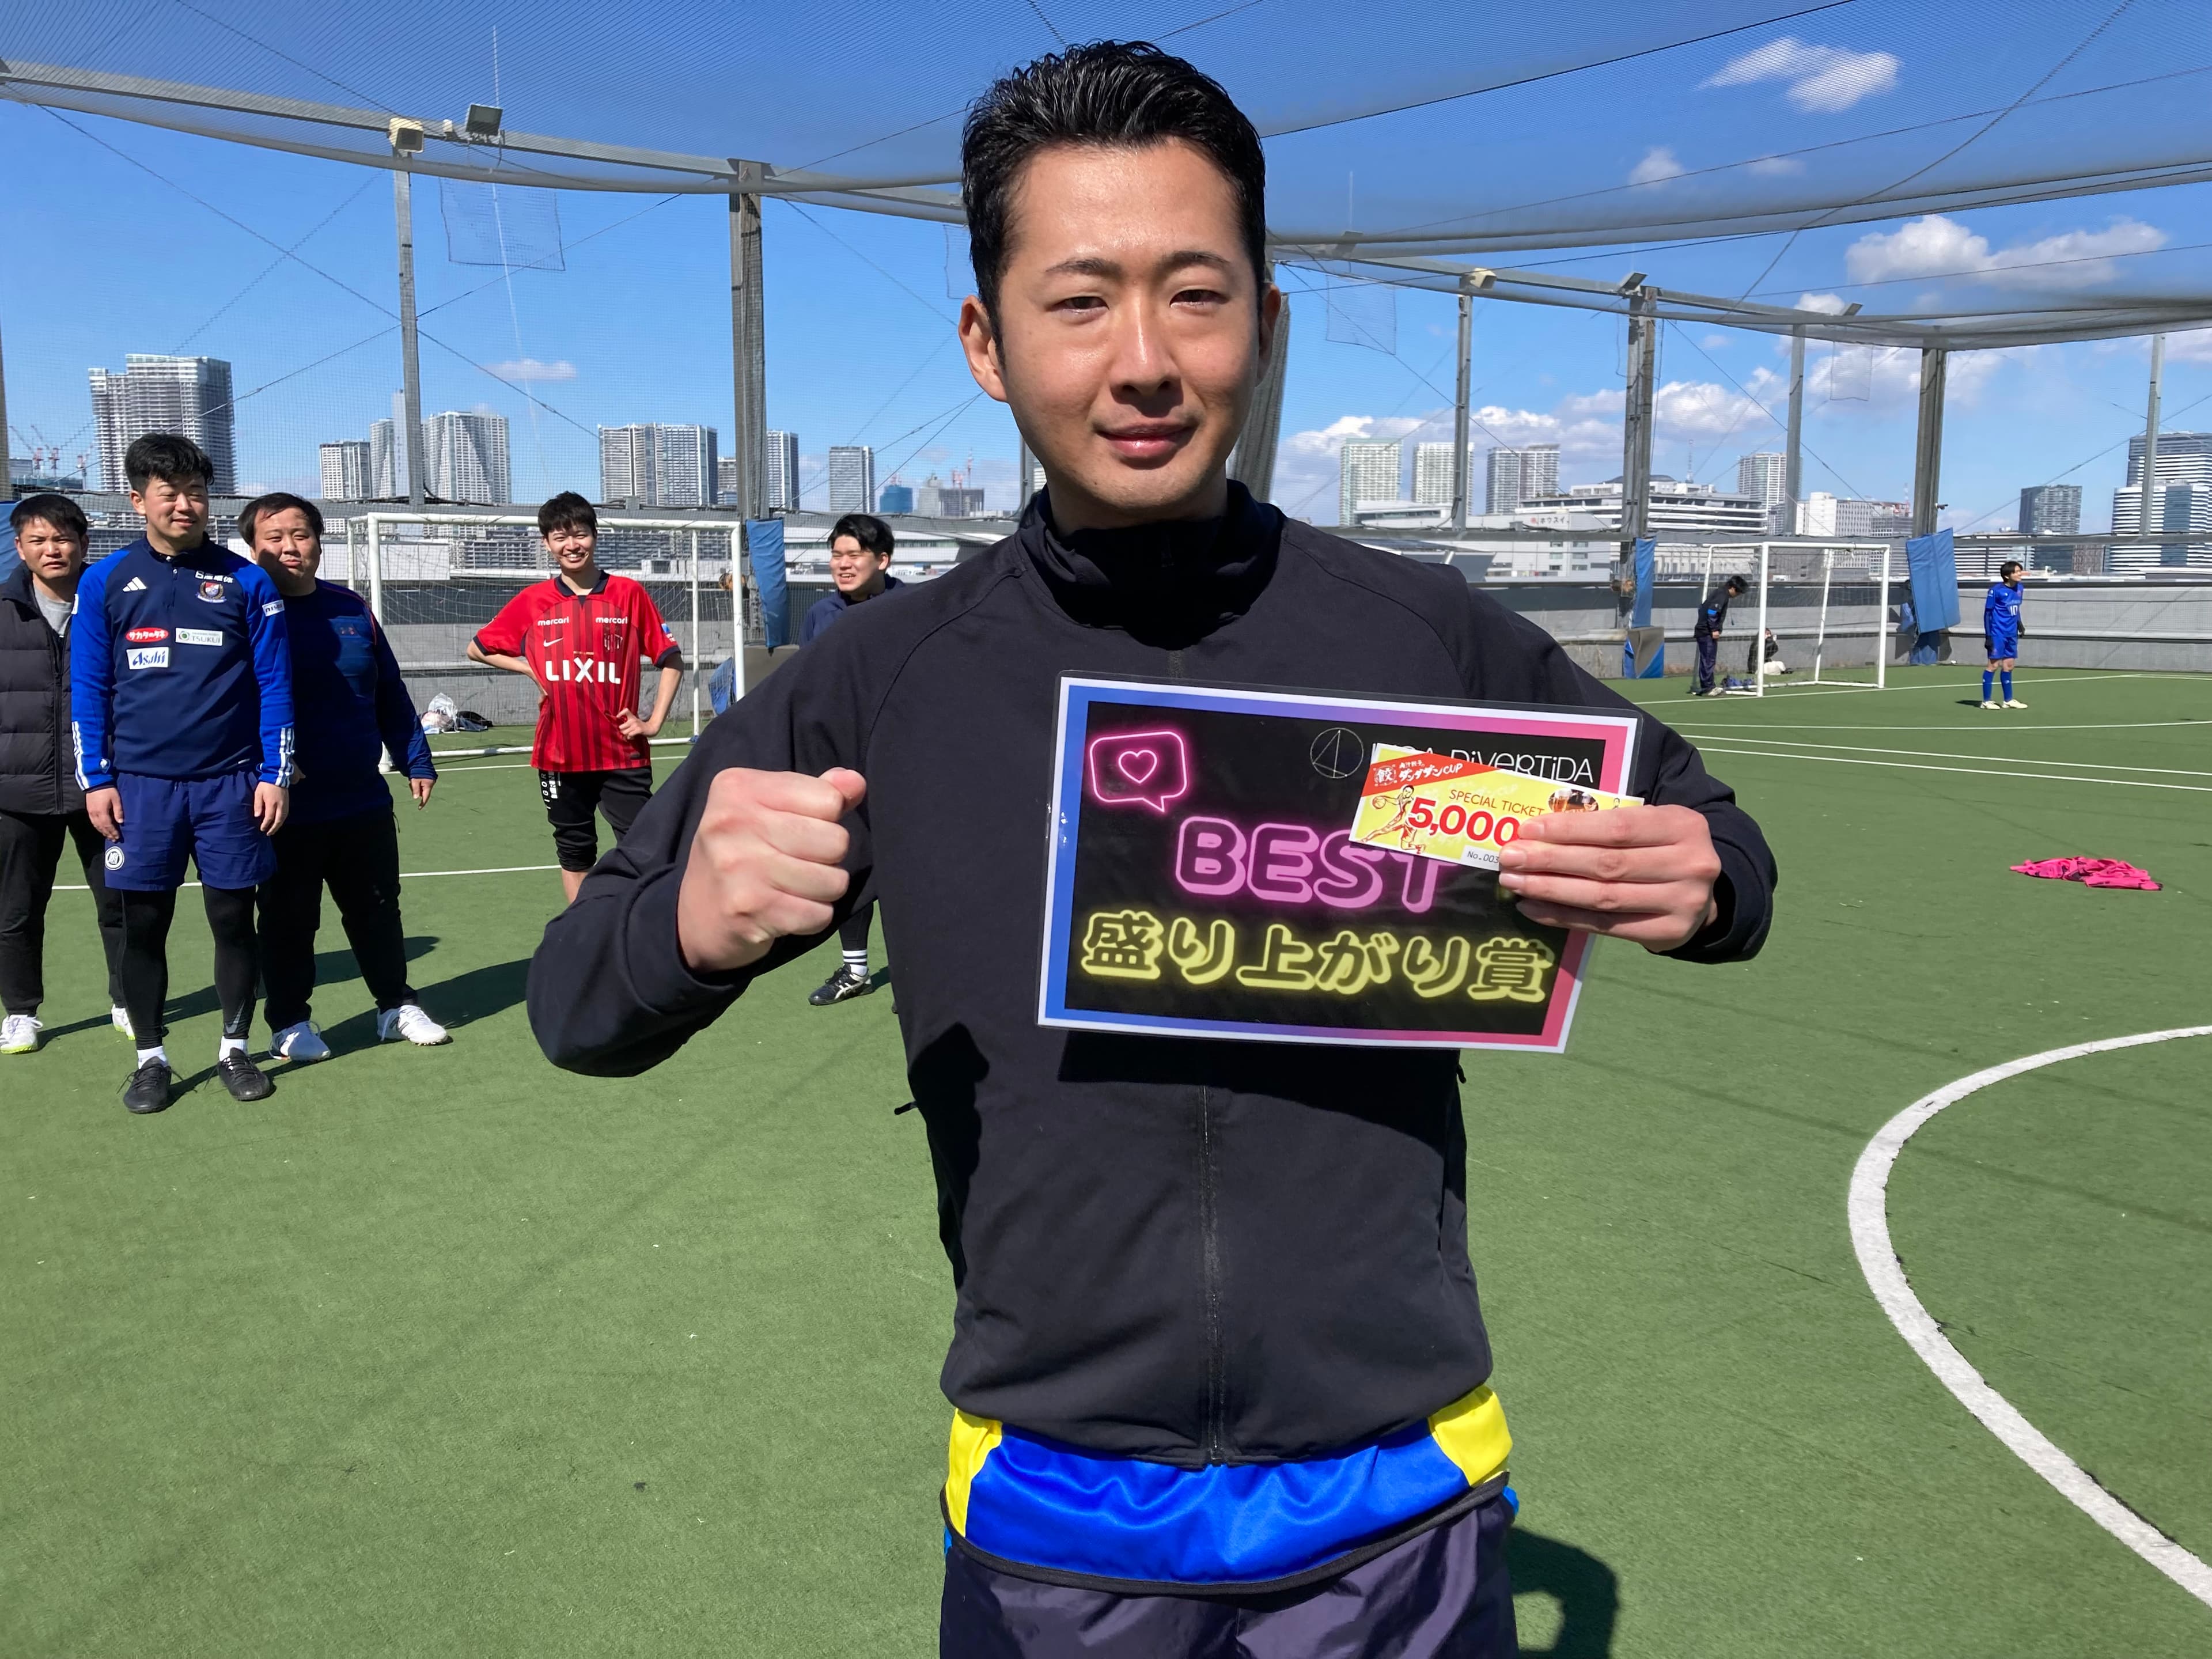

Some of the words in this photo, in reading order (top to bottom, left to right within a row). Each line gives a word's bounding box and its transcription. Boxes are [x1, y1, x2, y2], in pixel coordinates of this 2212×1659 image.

[2010, 605, 2018, 616] 10
[537, 616, 569, 626] mercari
[596, 616, 628, 624] mercari
[128, 630, 166, 640] サカタのタネ
[192, 635, 221, 643] TSUKUI
[132, 650, 165, 666] Asahi
[546, 657, 620, 684] LIXIL
[1449, 789, 1498, 809] SPECIAL
[1502, 800, 1545, 817] TICKET
[1176, 816, 1459, 912] BEST
[1081, 909, 1555, 1003] 盛り上がり賞
